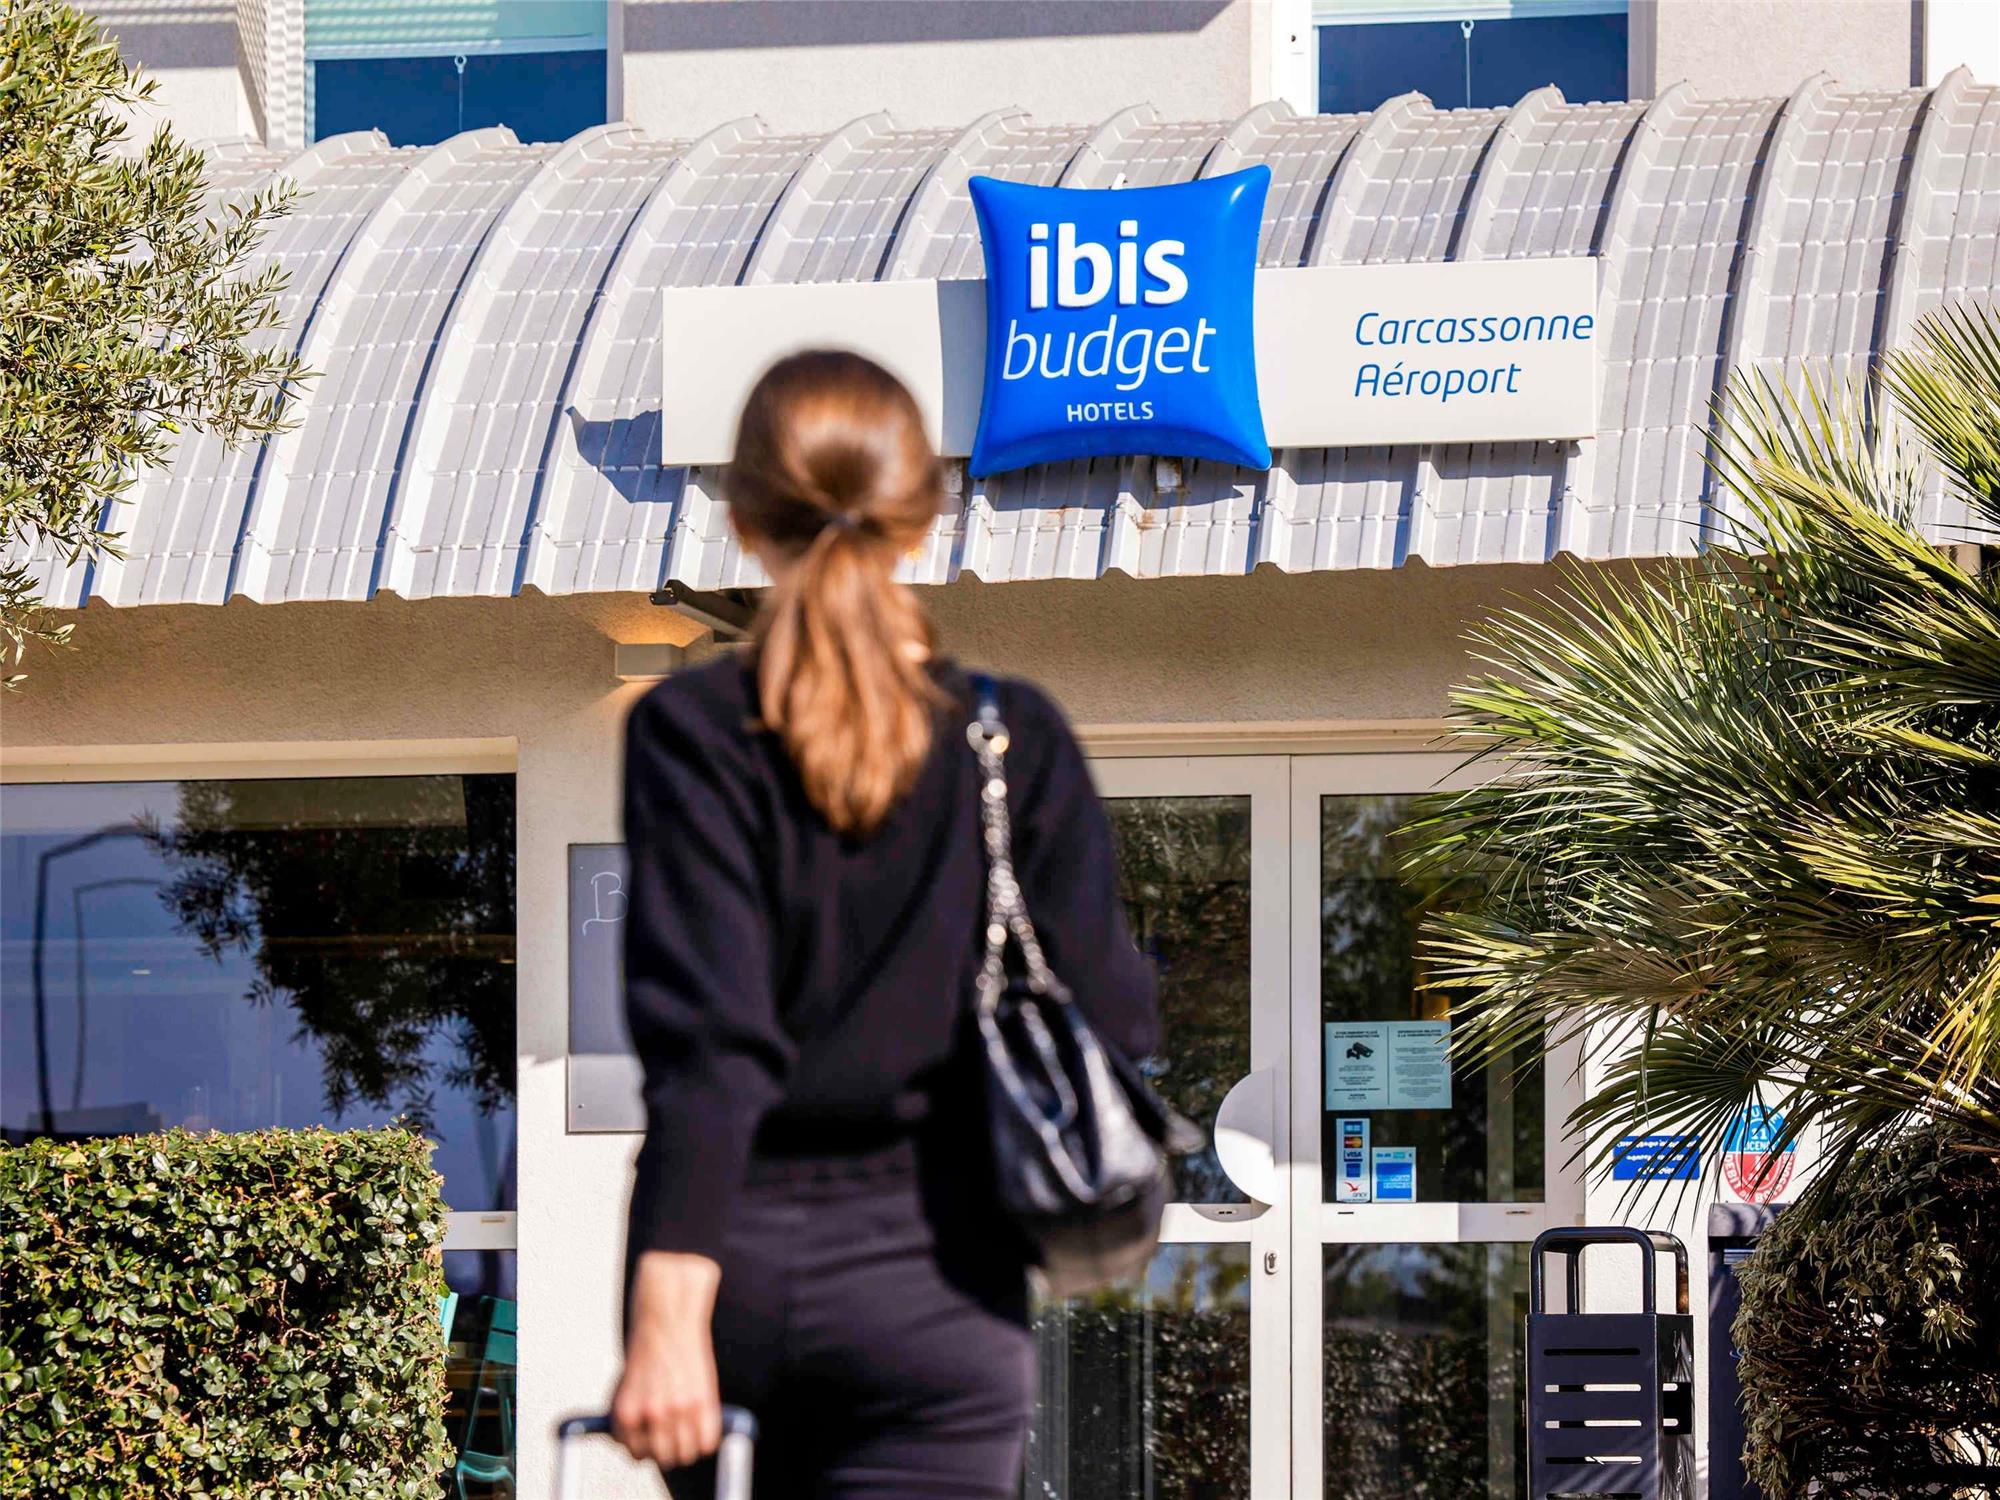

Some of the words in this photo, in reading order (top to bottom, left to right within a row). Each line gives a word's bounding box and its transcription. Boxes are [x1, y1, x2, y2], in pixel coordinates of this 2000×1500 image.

[1030, 220, 1188, 309] ibis
[1355, 312, 1594, 346] Carcassonne
[1003, 316, 1217, 391] budget
[1354, 361, 1522, 403] Aéroport
[1066, 400, 1154, 423] HOTELS
